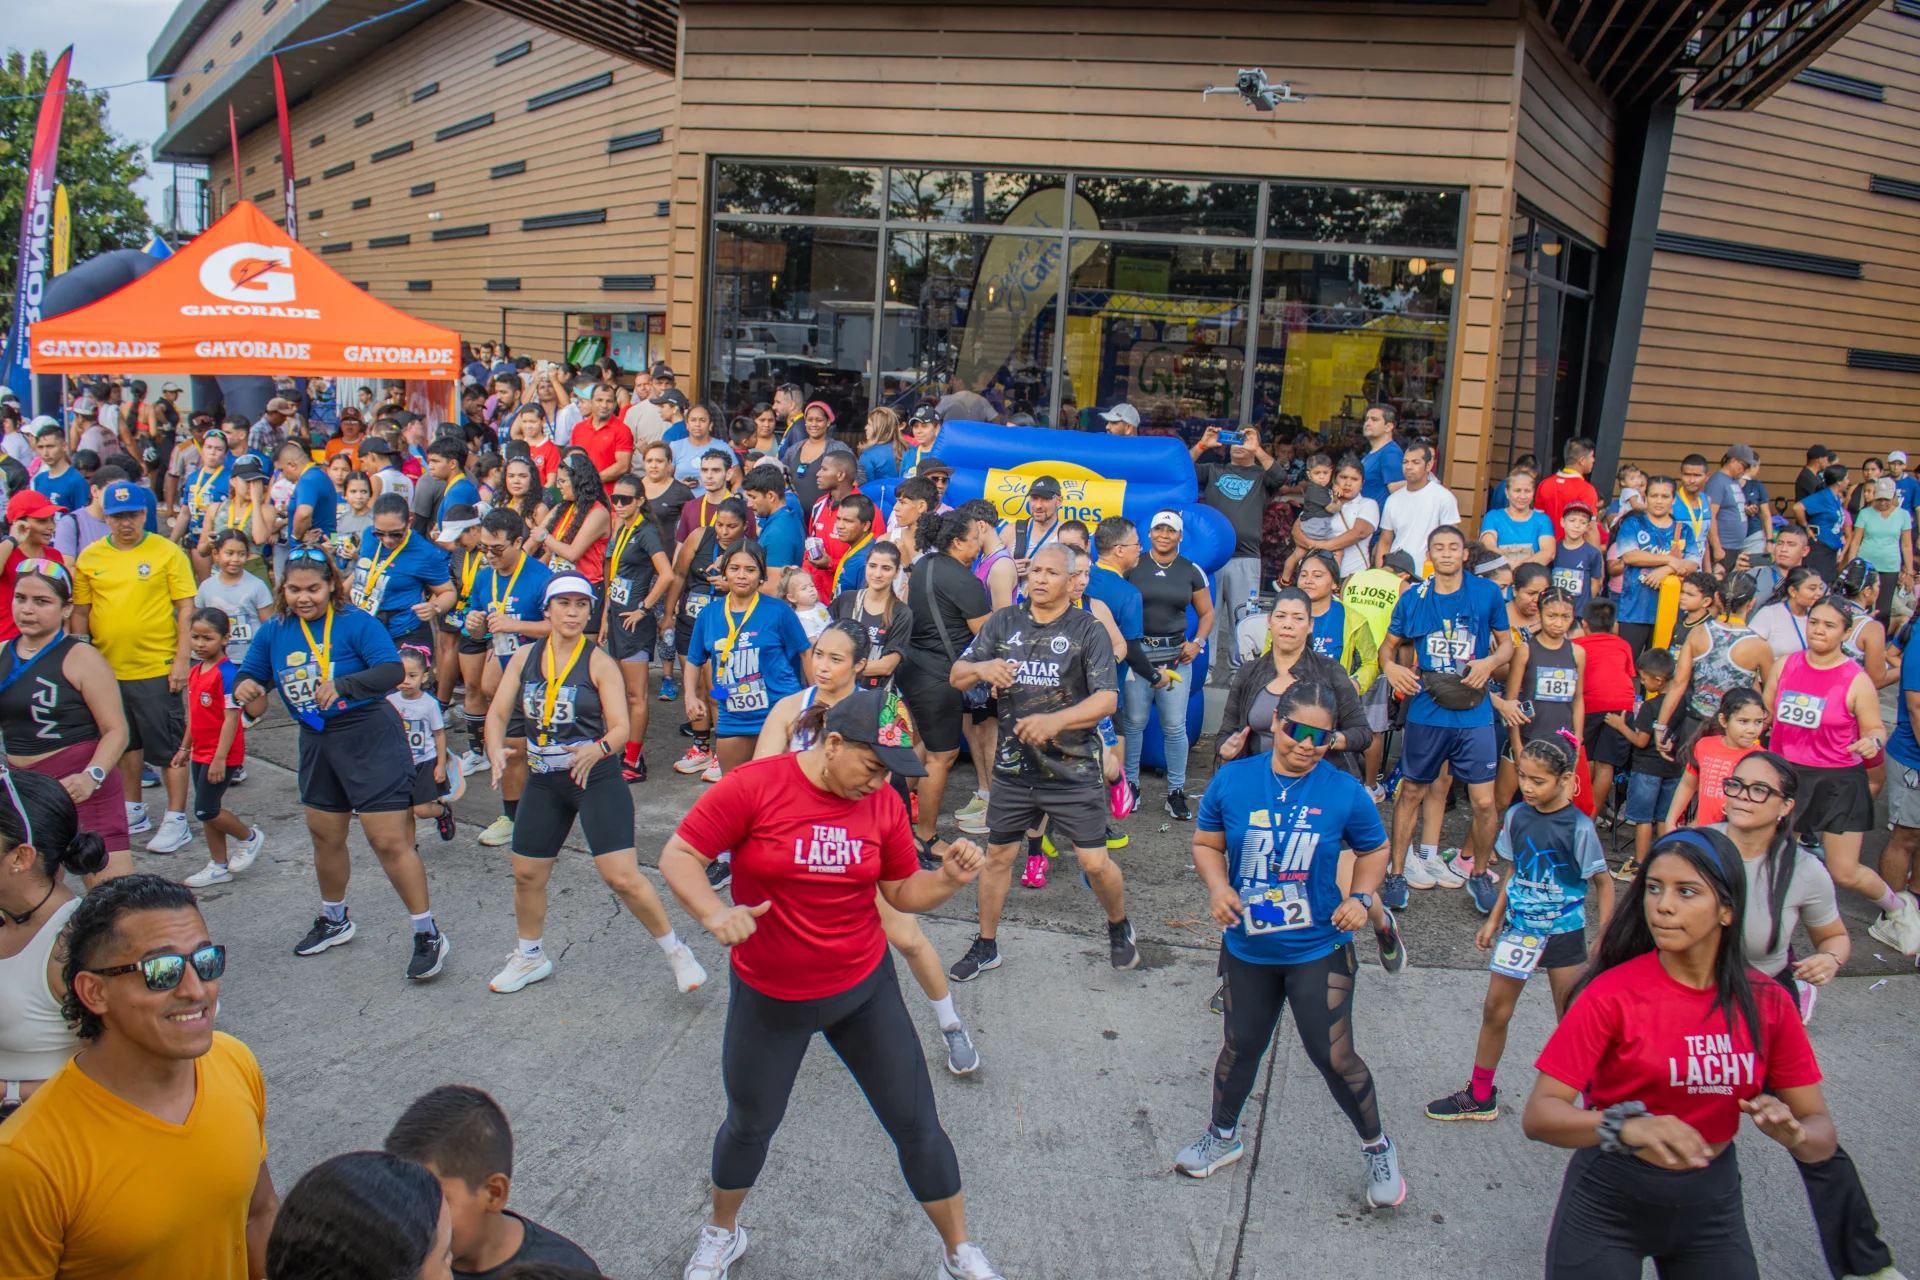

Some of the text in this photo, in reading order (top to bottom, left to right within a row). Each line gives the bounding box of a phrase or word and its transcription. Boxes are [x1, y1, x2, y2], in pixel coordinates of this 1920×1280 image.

[180, 305, 320, 319] GATORADE
[38, 340, 160, 358] GATORADE
[195, 341, 311, 360] GATORADE
[343, 345, 453, 365] GATORADE
[1554, 577, 1577, 591] 196
[353, 591, 375, 612] 113
[1346, 585, 1397, 605] M. JOSÉ
[1430, 640, 1468, 659] 1257
[715, 647, 760, 685] RUN
[1014, 674, 1060, 687] AIRWAYS
[1545, 680, 1569, 694] 181
[730, 692, 764, 709] 1301
[1779, 705, 1816, 725] 299
[812, 825, 847, 842] TEAM
[794, 838, 863, 865] LACHY
[1240, 829, 1321, 881] RUN
[1507, 948, 1536, 968] 97
[1684, 1033, 1733, 1056] TEAM
[1669, 1052, 1755, 1087] LACHY
[1687, 1085, 1734, 1095] BY CHANGES
